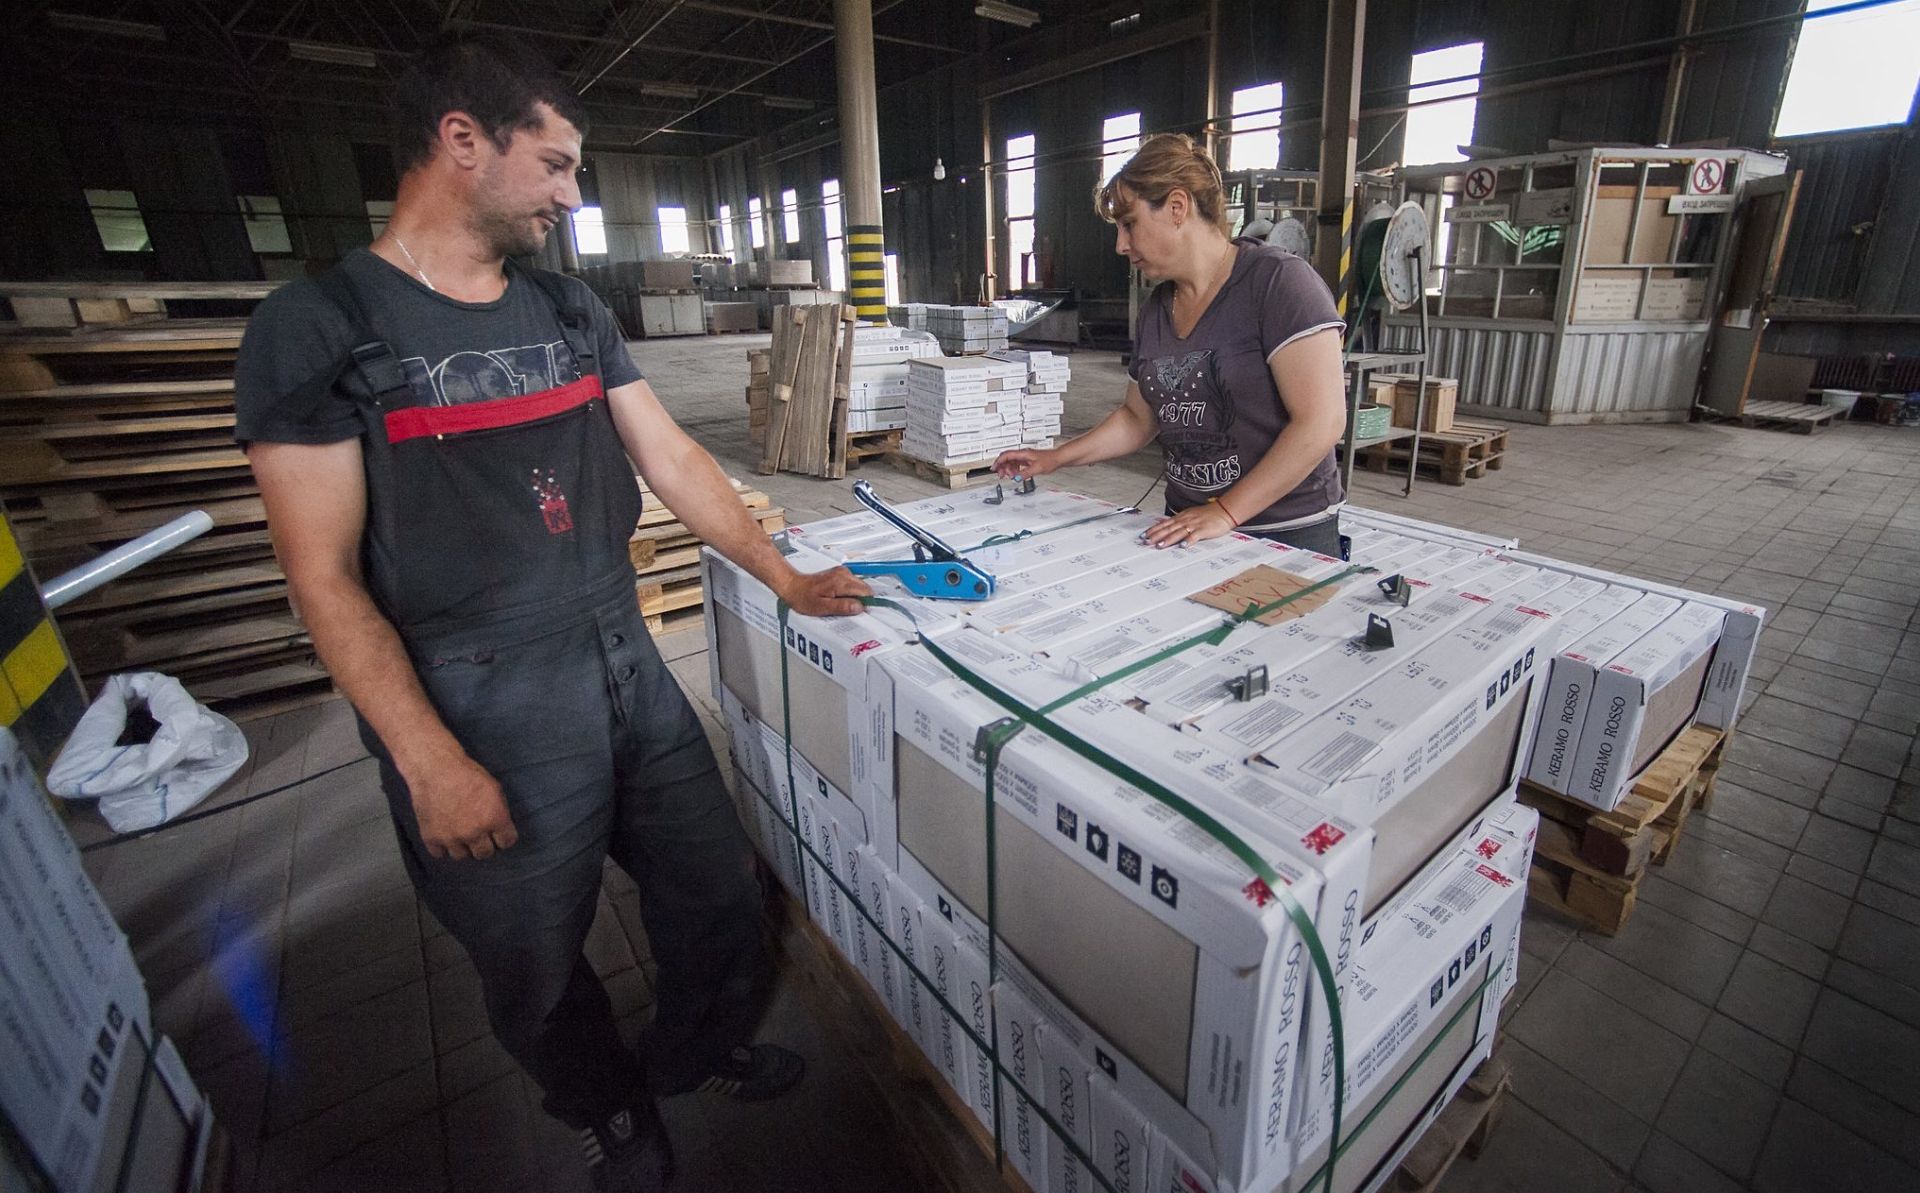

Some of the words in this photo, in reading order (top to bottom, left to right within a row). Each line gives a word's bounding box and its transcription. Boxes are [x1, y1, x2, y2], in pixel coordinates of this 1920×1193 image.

[1158, 401, 1207, 427] 1977
[1548, 728, 1569, 777] KERAMO
[1561, 683, 1581, 724] ROSSO
[1589, 742, 1613, 792] KERAMO
[1604, 696, 1626, 738] ROSSO
[1335, 889, 1358, 977] ROSSO
[971, 980, 986, 1047] ROSSO
[1265, 1041, 1290, 1146] KERAMO
[1278, 942, 1303, 1035] ROSSO
[1011, 1020, 1027, 1086] ROSSO
[1059, 1066, 1077, 1135] ROSSO
